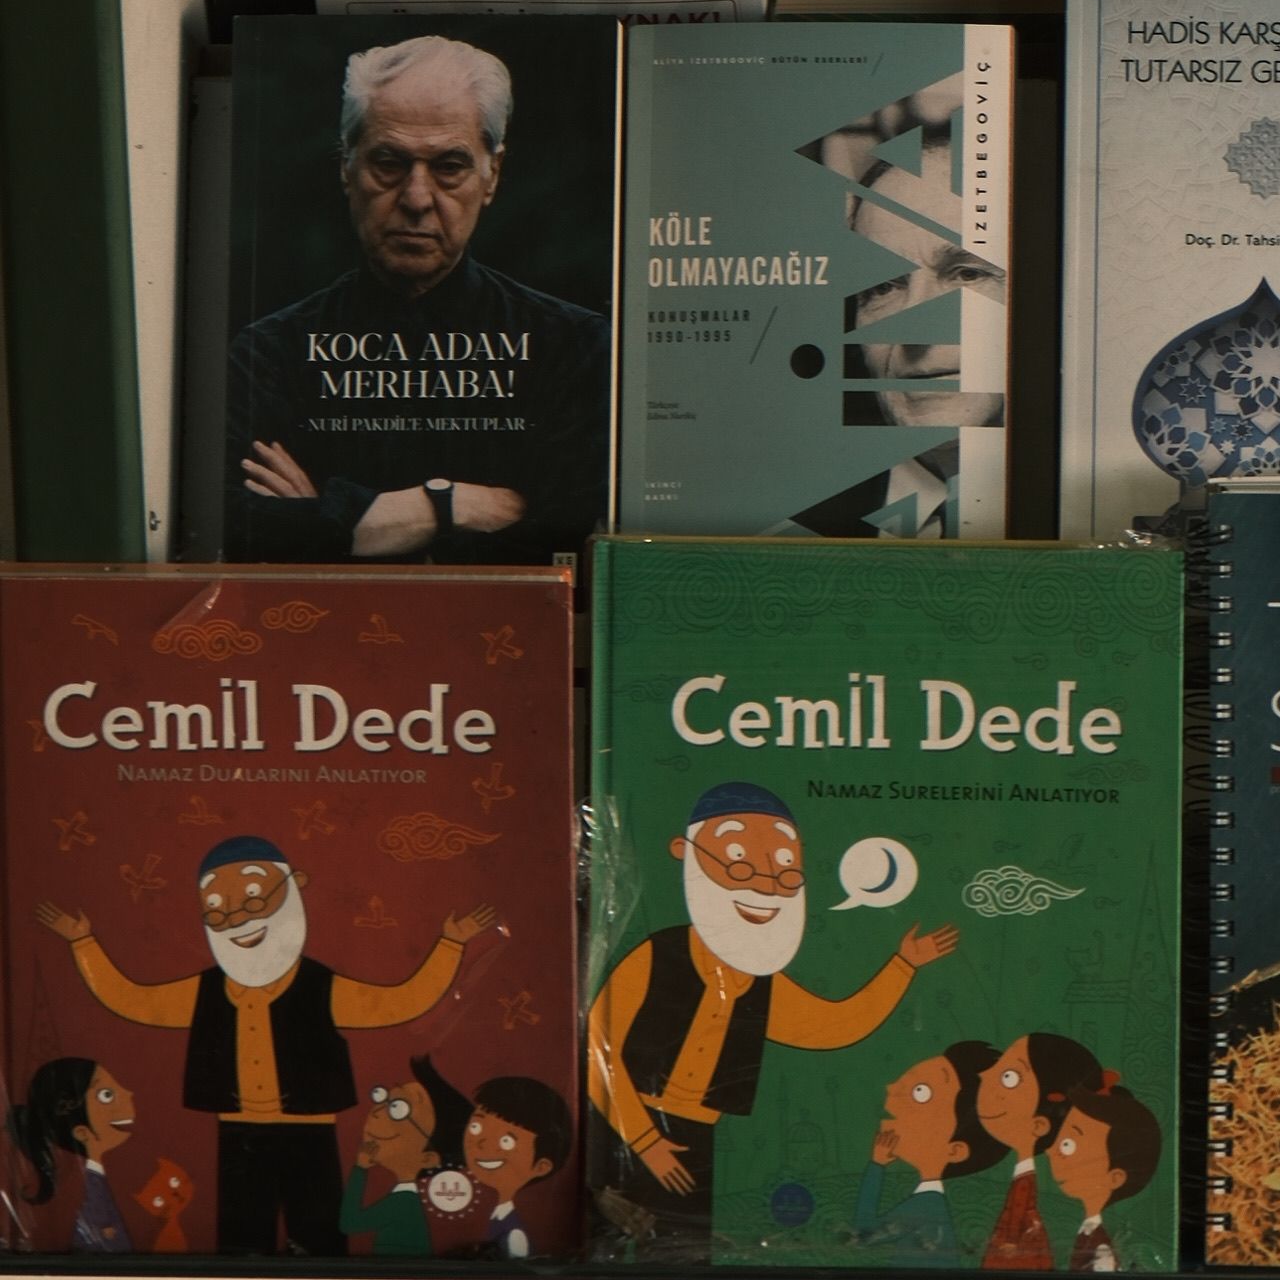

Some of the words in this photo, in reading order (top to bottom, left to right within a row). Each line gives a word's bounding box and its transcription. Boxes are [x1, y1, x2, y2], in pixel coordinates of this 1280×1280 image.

[1128, 16, 1210, 44] HADİS
[1120, 59, 1242, 83] TUTARSIZ
[650, 212, 712, 246] KÖLE
[1185, 233, 1215, 248] Doç.
[1221, 234, 1240, 245] Dr.
[648, 250, 829, 287] OLMAYACAĞIZ
[648, 310, 750, 324] KONUŞMALAR
[306, 332, 409, 362] KOCA
[419, 332, 531, 361] ADAM
[319, 369, 515, 399] MERHABA!
[308, 415, 348, 432] NURİ
[425, 417, 526, 432] MEKTUPLAR
[43, 677, 265, 751] Cemil
[291, 683, 496, 754] Dede
[672, 672, 891, 749] Cemil
[920, 679, 1122, 755] Dede
[117, 763, 193, 782] NAMAZ
[316, 764, 427, 783] ANLATIYOR
[807, 780, 882, 800] NAMAZ
[1003, 784, 1120, 804] ANLATIYOR
